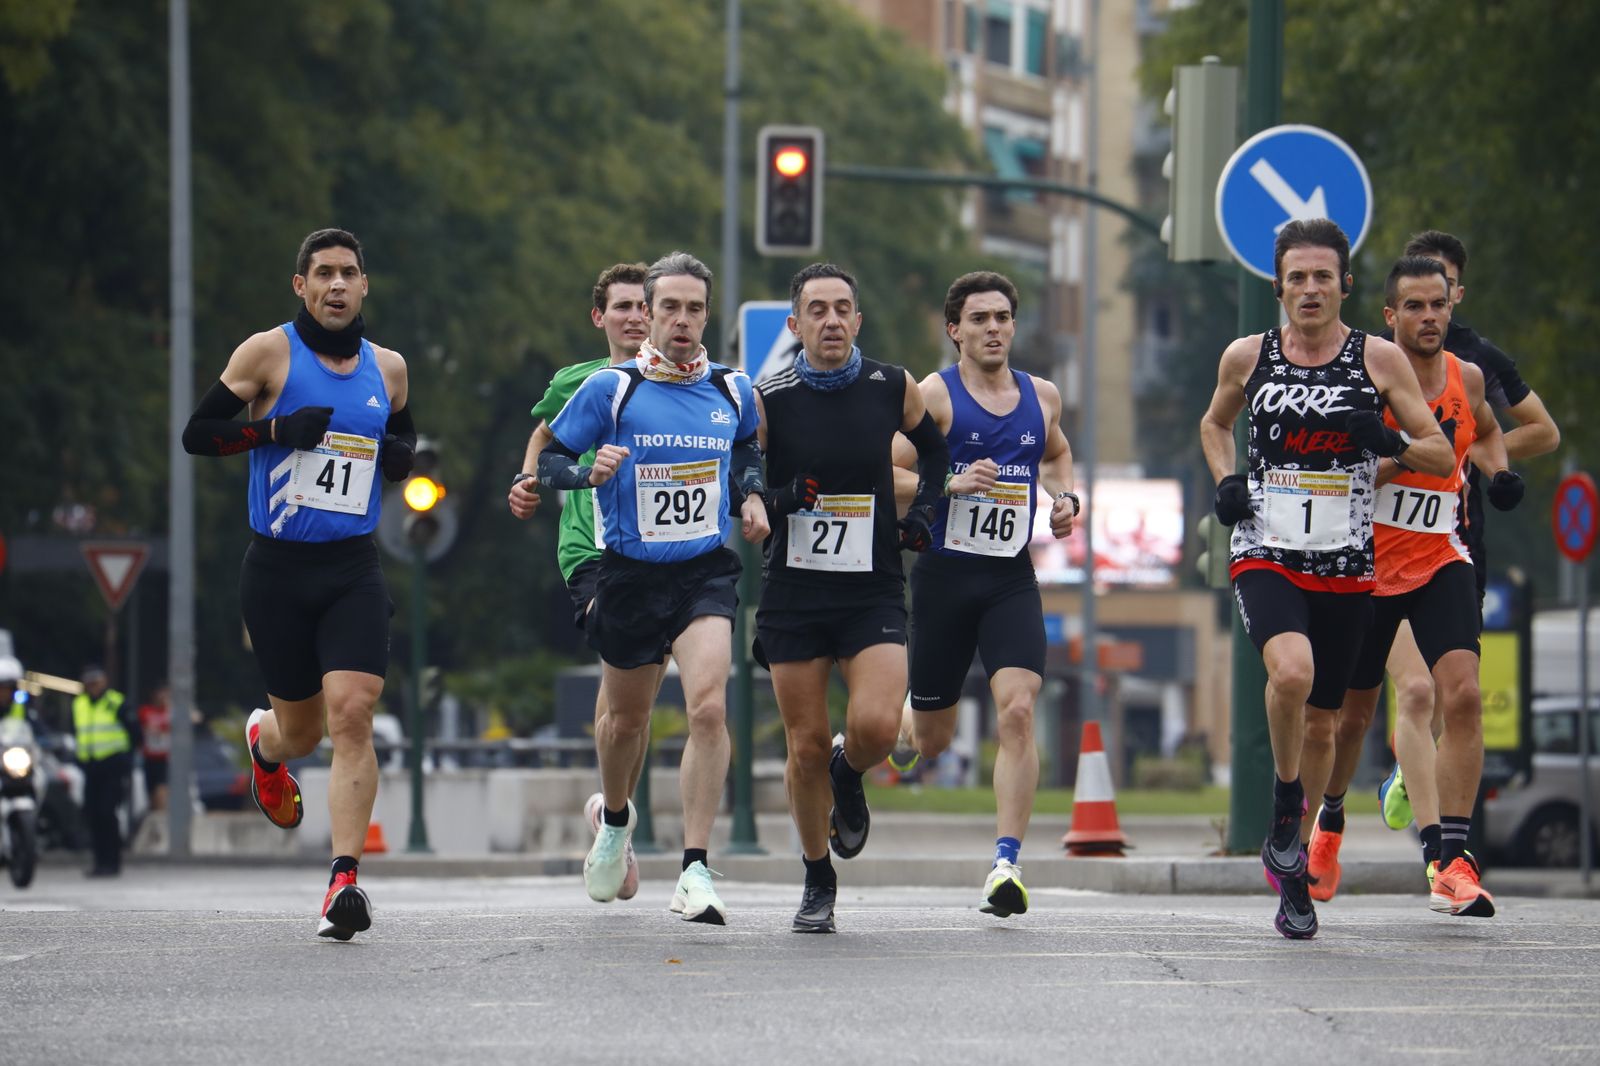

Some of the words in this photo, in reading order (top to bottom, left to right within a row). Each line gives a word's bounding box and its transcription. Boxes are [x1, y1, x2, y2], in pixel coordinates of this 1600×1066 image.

[1252, 382, 1355, 420] CORRE
[633, 434, 731, 452] TROTASIERRA
[1269, 423, 1281, 441] O
[1283, 428, 1356, 455] MUERE
[316, 459, 352, 496] 41
[639, 467, 672, 480] XXXIX
[954, 462, 1031, 477] TRSIERRA
[1268, 473, 1298, 487] XXXIX
[654, 488, 707, 526] 292
[969, 505, 1016, 542] 146
[1301, 498, 1313, 535] 1
[1391, 489, 1441, 528] 170
[812, 520, 848, 555] 27
